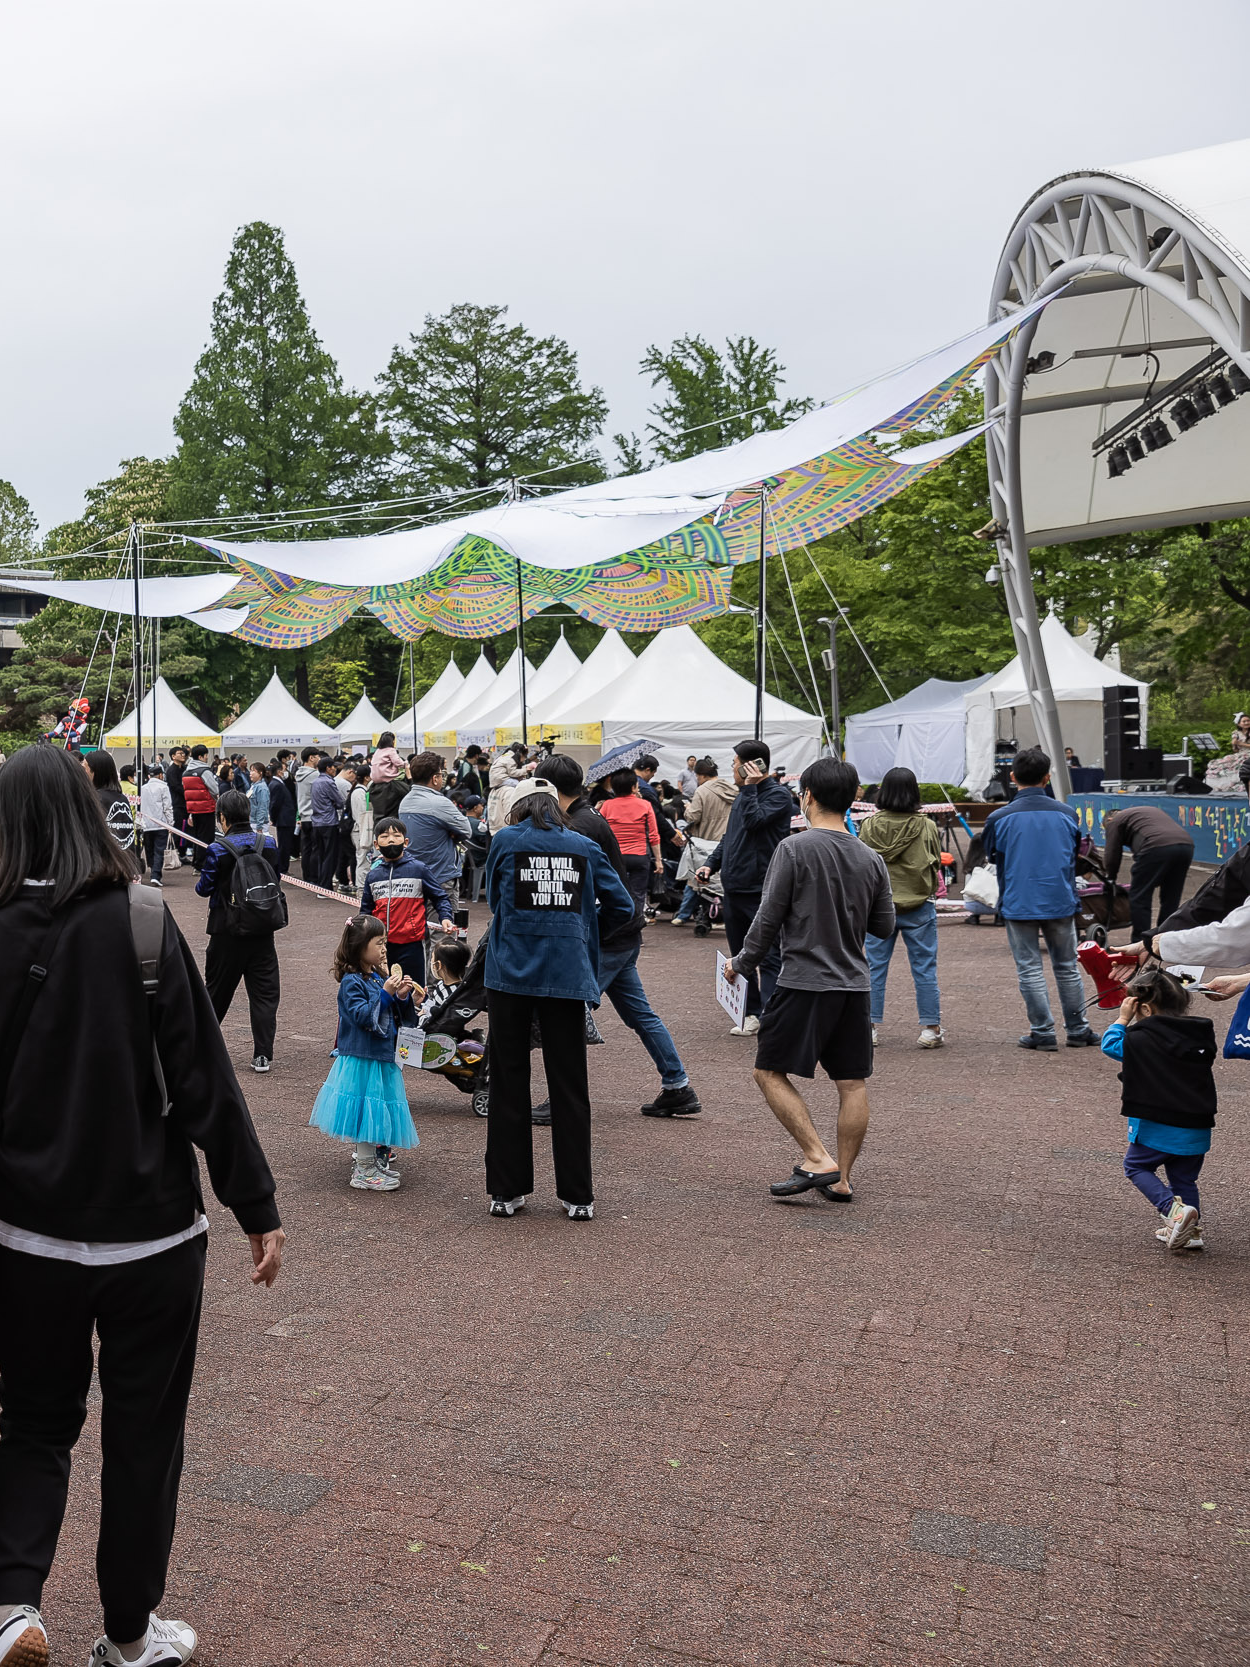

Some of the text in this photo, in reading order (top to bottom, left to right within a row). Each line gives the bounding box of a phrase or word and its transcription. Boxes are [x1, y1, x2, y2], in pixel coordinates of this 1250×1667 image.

[528, 856, 574, 870] YOU WILL
[520, 868, 580, 884] NEVER KNOW
[537, 881, 565, 893] UNTIL
[531, 892, 573, 906] YOU TRY
